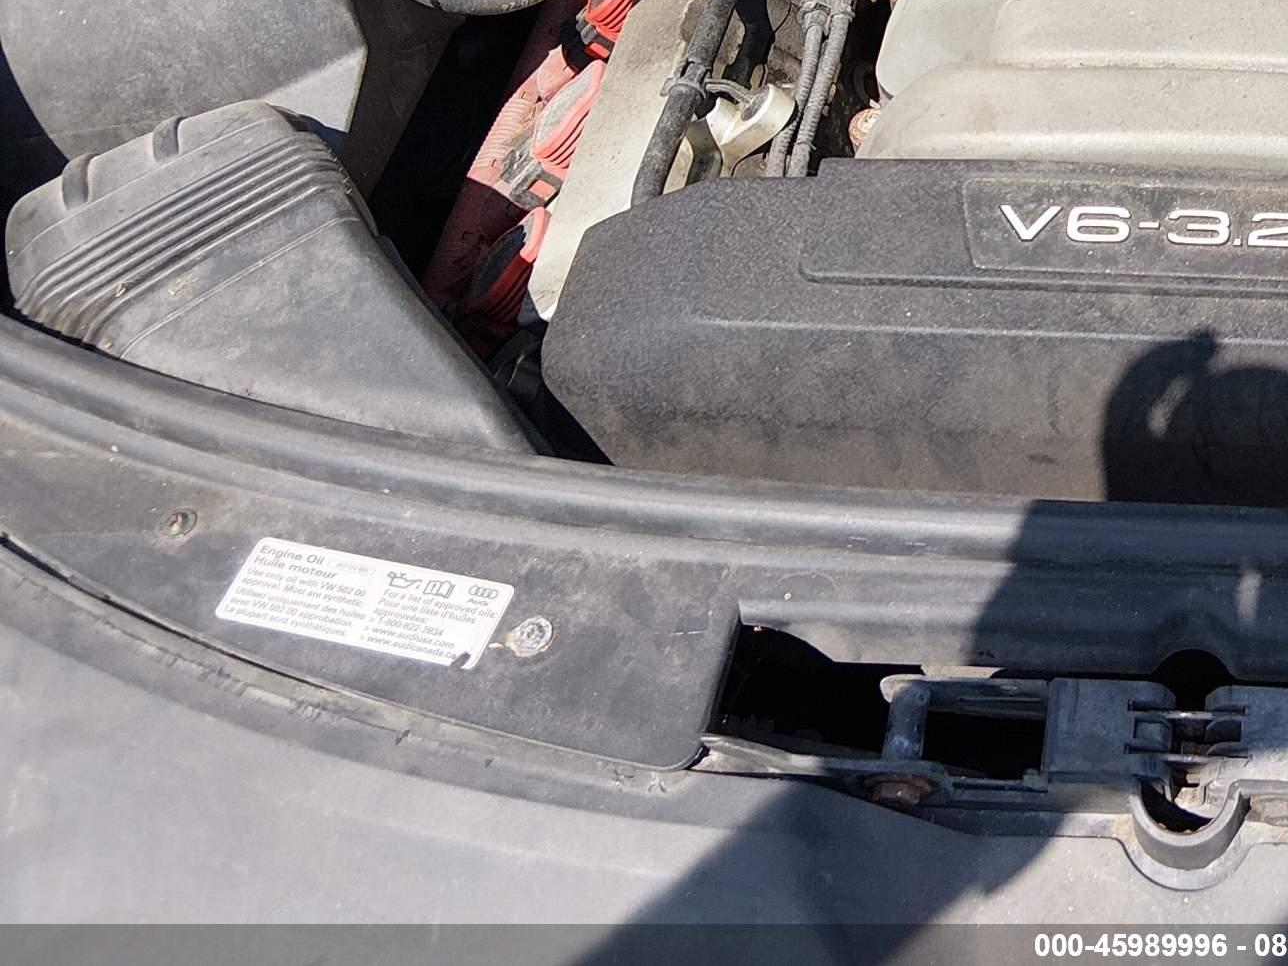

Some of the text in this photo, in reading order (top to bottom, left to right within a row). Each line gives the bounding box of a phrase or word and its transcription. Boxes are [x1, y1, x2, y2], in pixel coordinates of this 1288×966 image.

[252, 555, 287, 569] Huile
[287, 563, 338, 579] moteur
[258, 545, 325, 564] Engine Oil
[246, 567, 262, 576] Use
[259, 570, 284, 581] only
[298, 578, 318, 587] with
[318, 581, 337, 591] VW
[335, 585, 354, 594] 502
[353, 589, 367, 597] 00
[233, 587, 267, 599] Utiliser
[320, 605, 337, 614] des
[337, 608, 366, 619] huiles
[282, 584, 307, 595] Most
[306, 590, 322, 598] are
[320, 592, 365, 608] synthetic.
[382, 589, 398, 598] For
[432, 600, 478, 616] approved
[228, 596, 249, 606] avec
[250, 600, 268, 609] VW
[296, 610, 354, 629] approbation.
[234, 607, 268, 621] plupart
[268, 614, 288, 624] sont
[372, 607, 428, 625] approuvées:
[377, 598, 477, 624] Pour une liste d'huiles
[365, 634, 457, 660] www.audicanada.ca
[371, 626, 455, 649] www.audiusa.com
